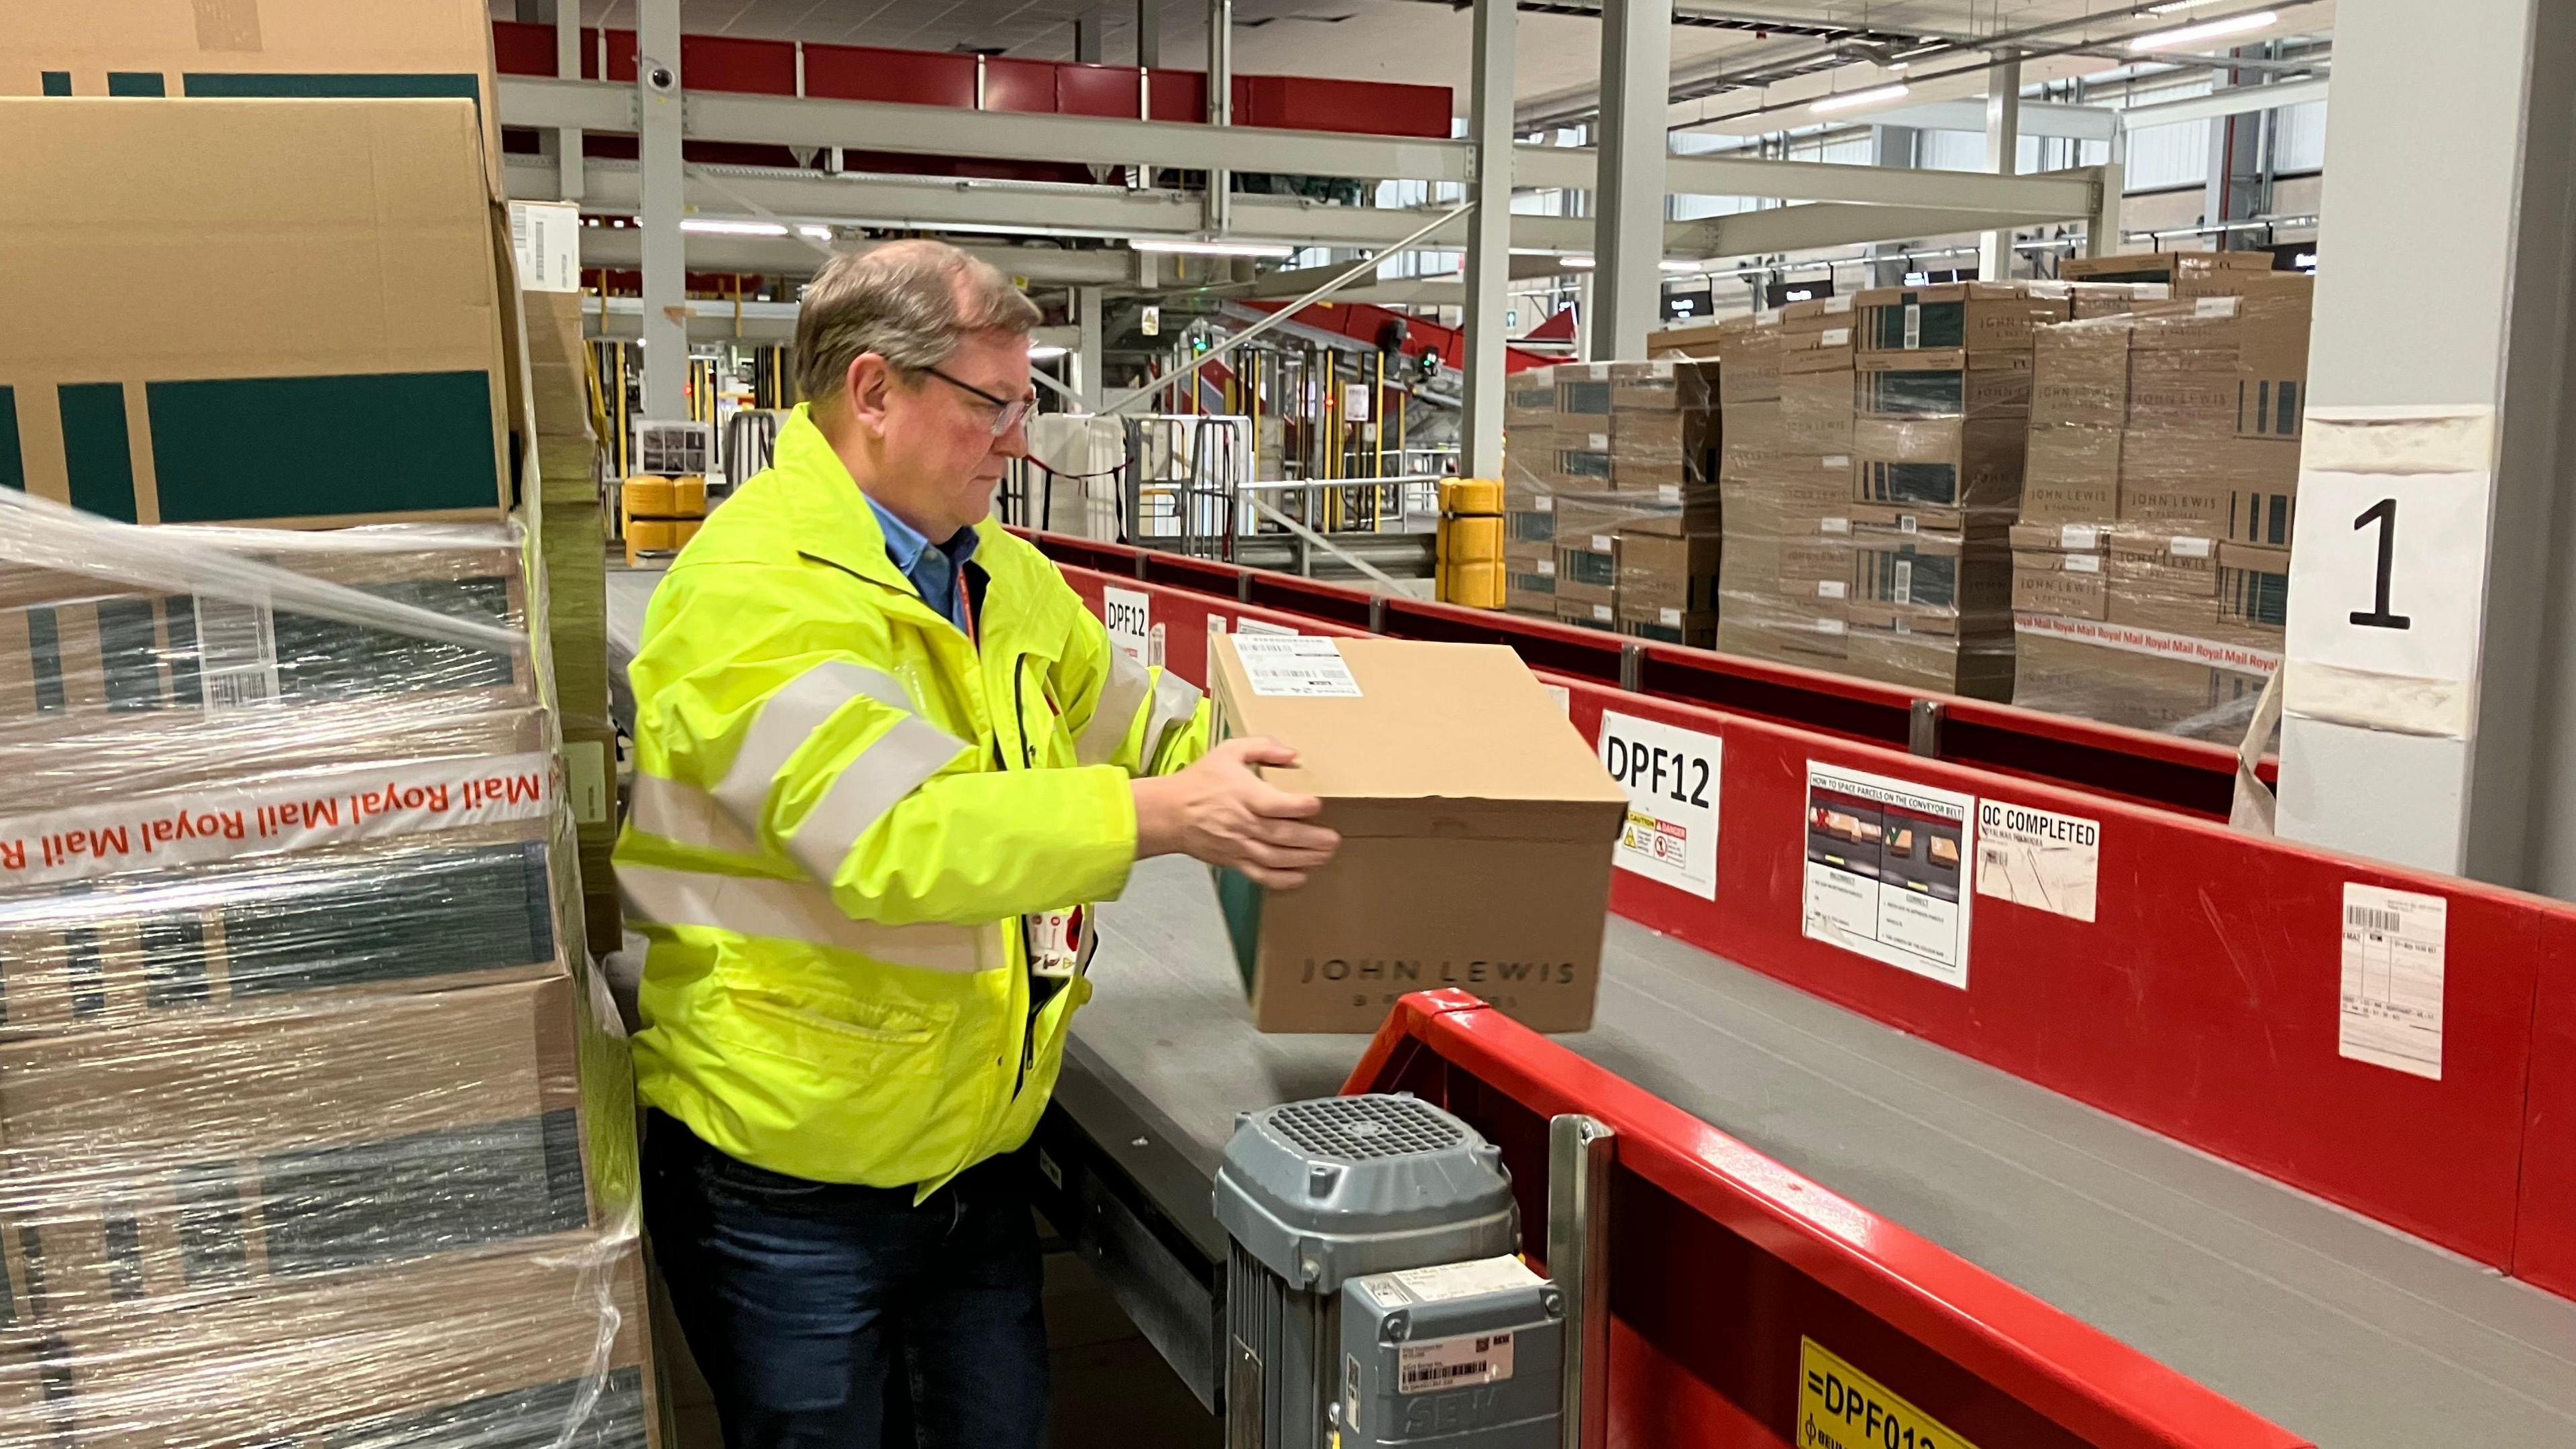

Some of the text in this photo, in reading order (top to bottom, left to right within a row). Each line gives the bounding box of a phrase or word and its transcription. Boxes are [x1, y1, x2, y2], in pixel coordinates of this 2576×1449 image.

[2032, 488, 2106, 502] JOHN LEWIS
[2132, 493, 2216, 509] JOHN LEWIS
[2121, 551, 2157, 564] JOHN
[2349, 498, 2410, 630] 1
[2021, 578, 2097, 596] JOHN LEWIS
[1108, 602, 1145, 637] DPF12
[2034, 617, 2051, 629] Mail
[2053, 621, 2075, 635] Royal
[2077, 623, 2096, 637] Mail
[2098, 627, 2121, 642] Royal
[2123, 631, 2143, 645] Mail
[2145, 635, 2170, 651] Royal
[2172, 640, 2194, 654] Mail
[2196, 644, 2223, 661] Royal
[2225, 649, 2247, 665] Mail
[2249, 654, 2278, 671] Royal
[462, 773, 541, 811] Mail
[1607, 735, 1710, 809] DPF12
[257, 795, 338, 838] Mail
[351, 783, 449, 824] Royal
[1813, 777, 1962, 818] HOW TO SPACE PARCELS ON THE CONVEYOR BELT
[141, 810, 245, 853] Royal
[1630, 813, 1655, 827] CAUTION
[1983, 804, 2001, 826] QC
[2006, 810, 2095, 847] COMPLETED
[42, 826, 129, 867] Mail
[1301, 958, 1576, 985] JOHN LEWIS
